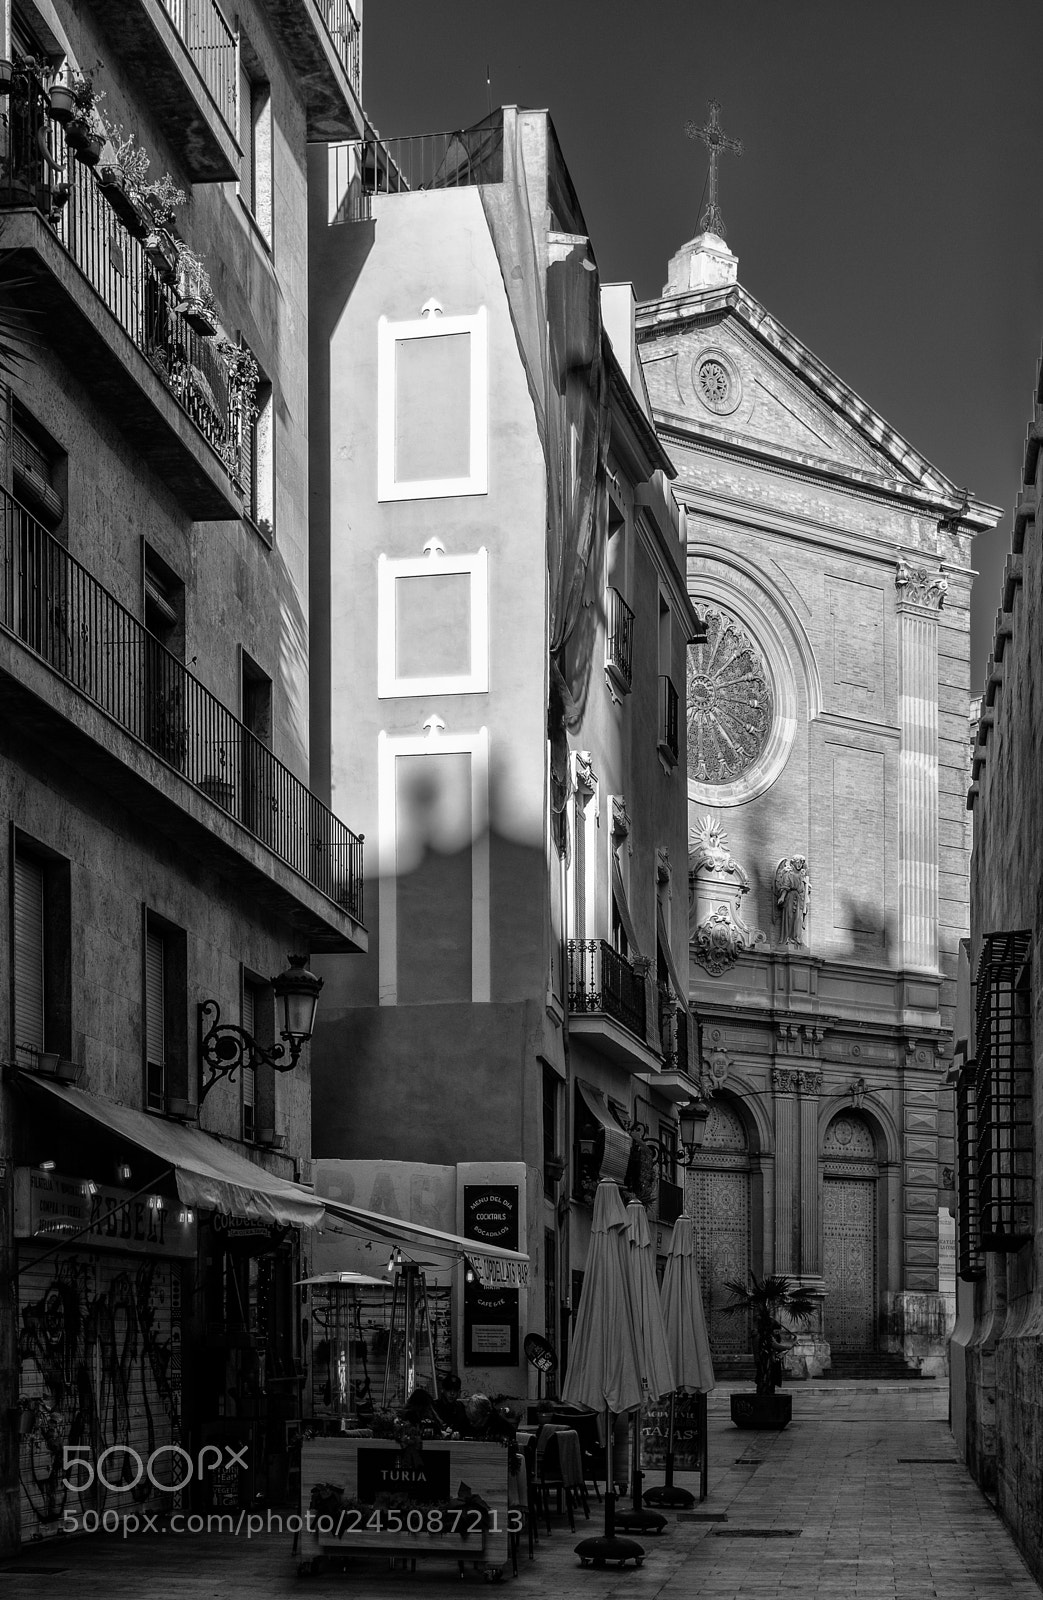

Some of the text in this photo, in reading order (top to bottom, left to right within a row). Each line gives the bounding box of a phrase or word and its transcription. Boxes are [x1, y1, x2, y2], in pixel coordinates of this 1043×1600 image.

[470, 1195, 513, 1211] MENU DEL DIA
[475, 1212, 507, 1221] COCKTAILS
[473, 1225, 509, 1237] BOCADILLOS
[517, 1263, 529, 1285] BAR
[477, 1298, 493, 1308] CAFE
[380, 1470, 427, 1482] TURIA
